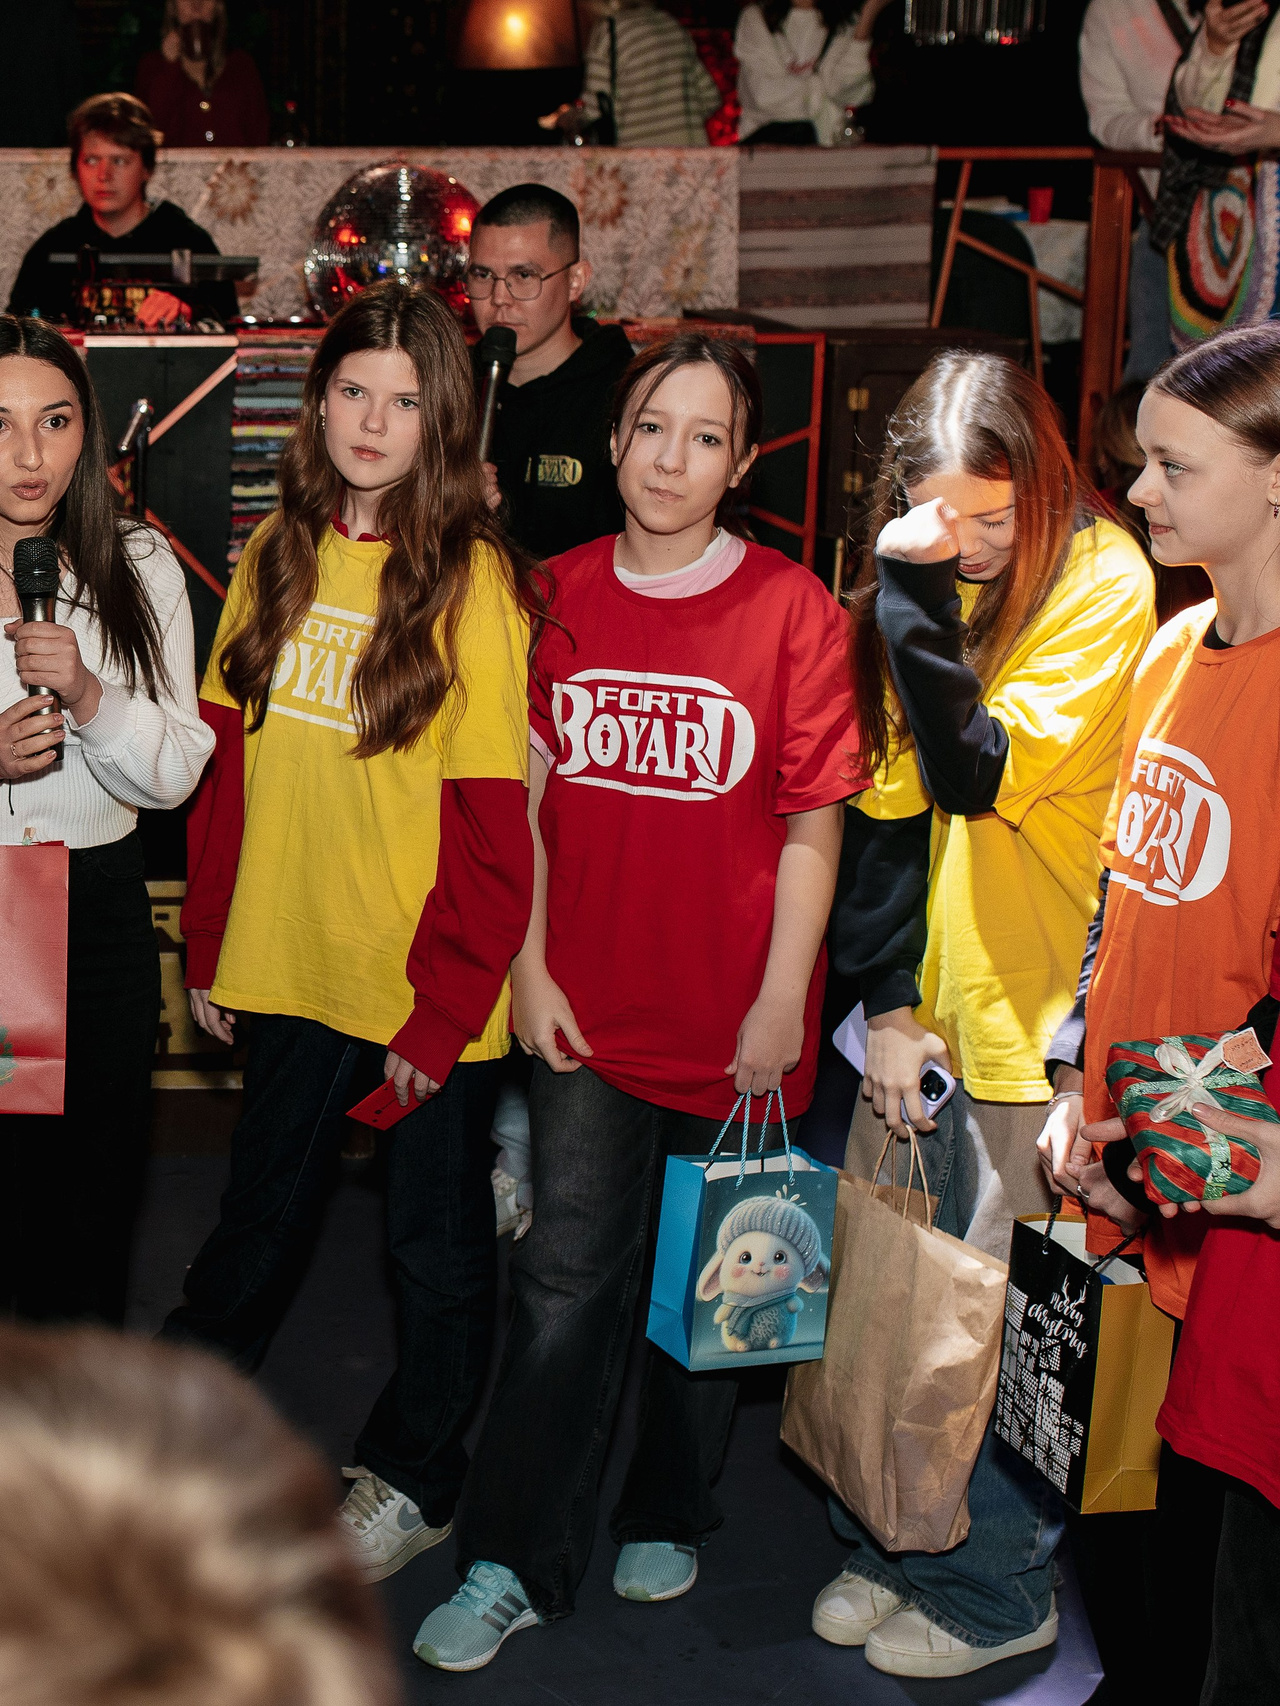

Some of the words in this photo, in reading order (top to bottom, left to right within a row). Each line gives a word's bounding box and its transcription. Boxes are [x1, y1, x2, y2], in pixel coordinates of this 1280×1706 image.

[297, 617, 368, 650] ORT
[596, 686, 695, 716] FORT
[552, 682, 756, 794] BOYARD
[1116, 777, 1232, 902] OYARD
